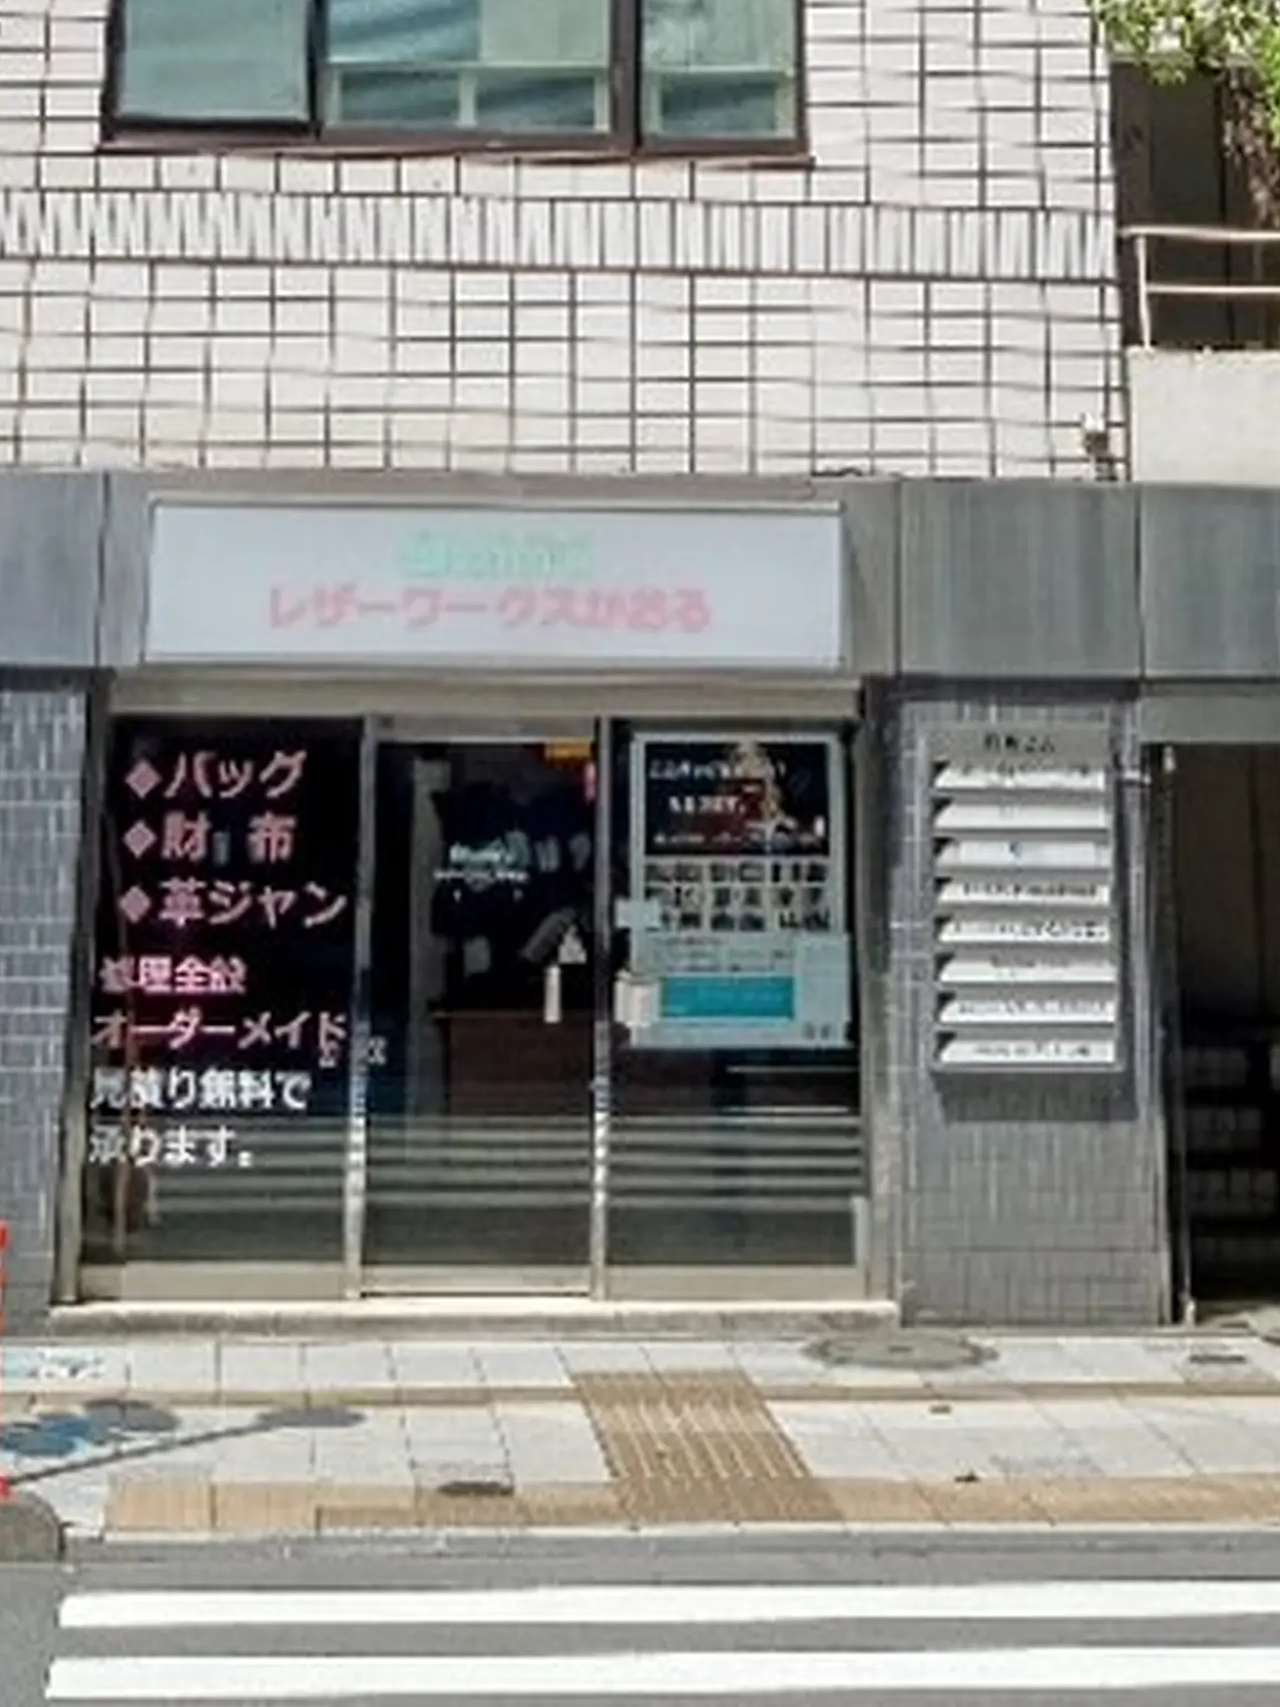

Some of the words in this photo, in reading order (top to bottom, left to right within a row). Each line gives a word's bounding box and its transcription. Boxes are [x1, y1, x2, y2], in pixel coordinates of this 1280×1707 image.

[158, 875, 348, 930] 革ジャン
[90, 1005, 348, 1051] オーダーメイド
[89, 1065, 313, 1111] 見積り無料で
